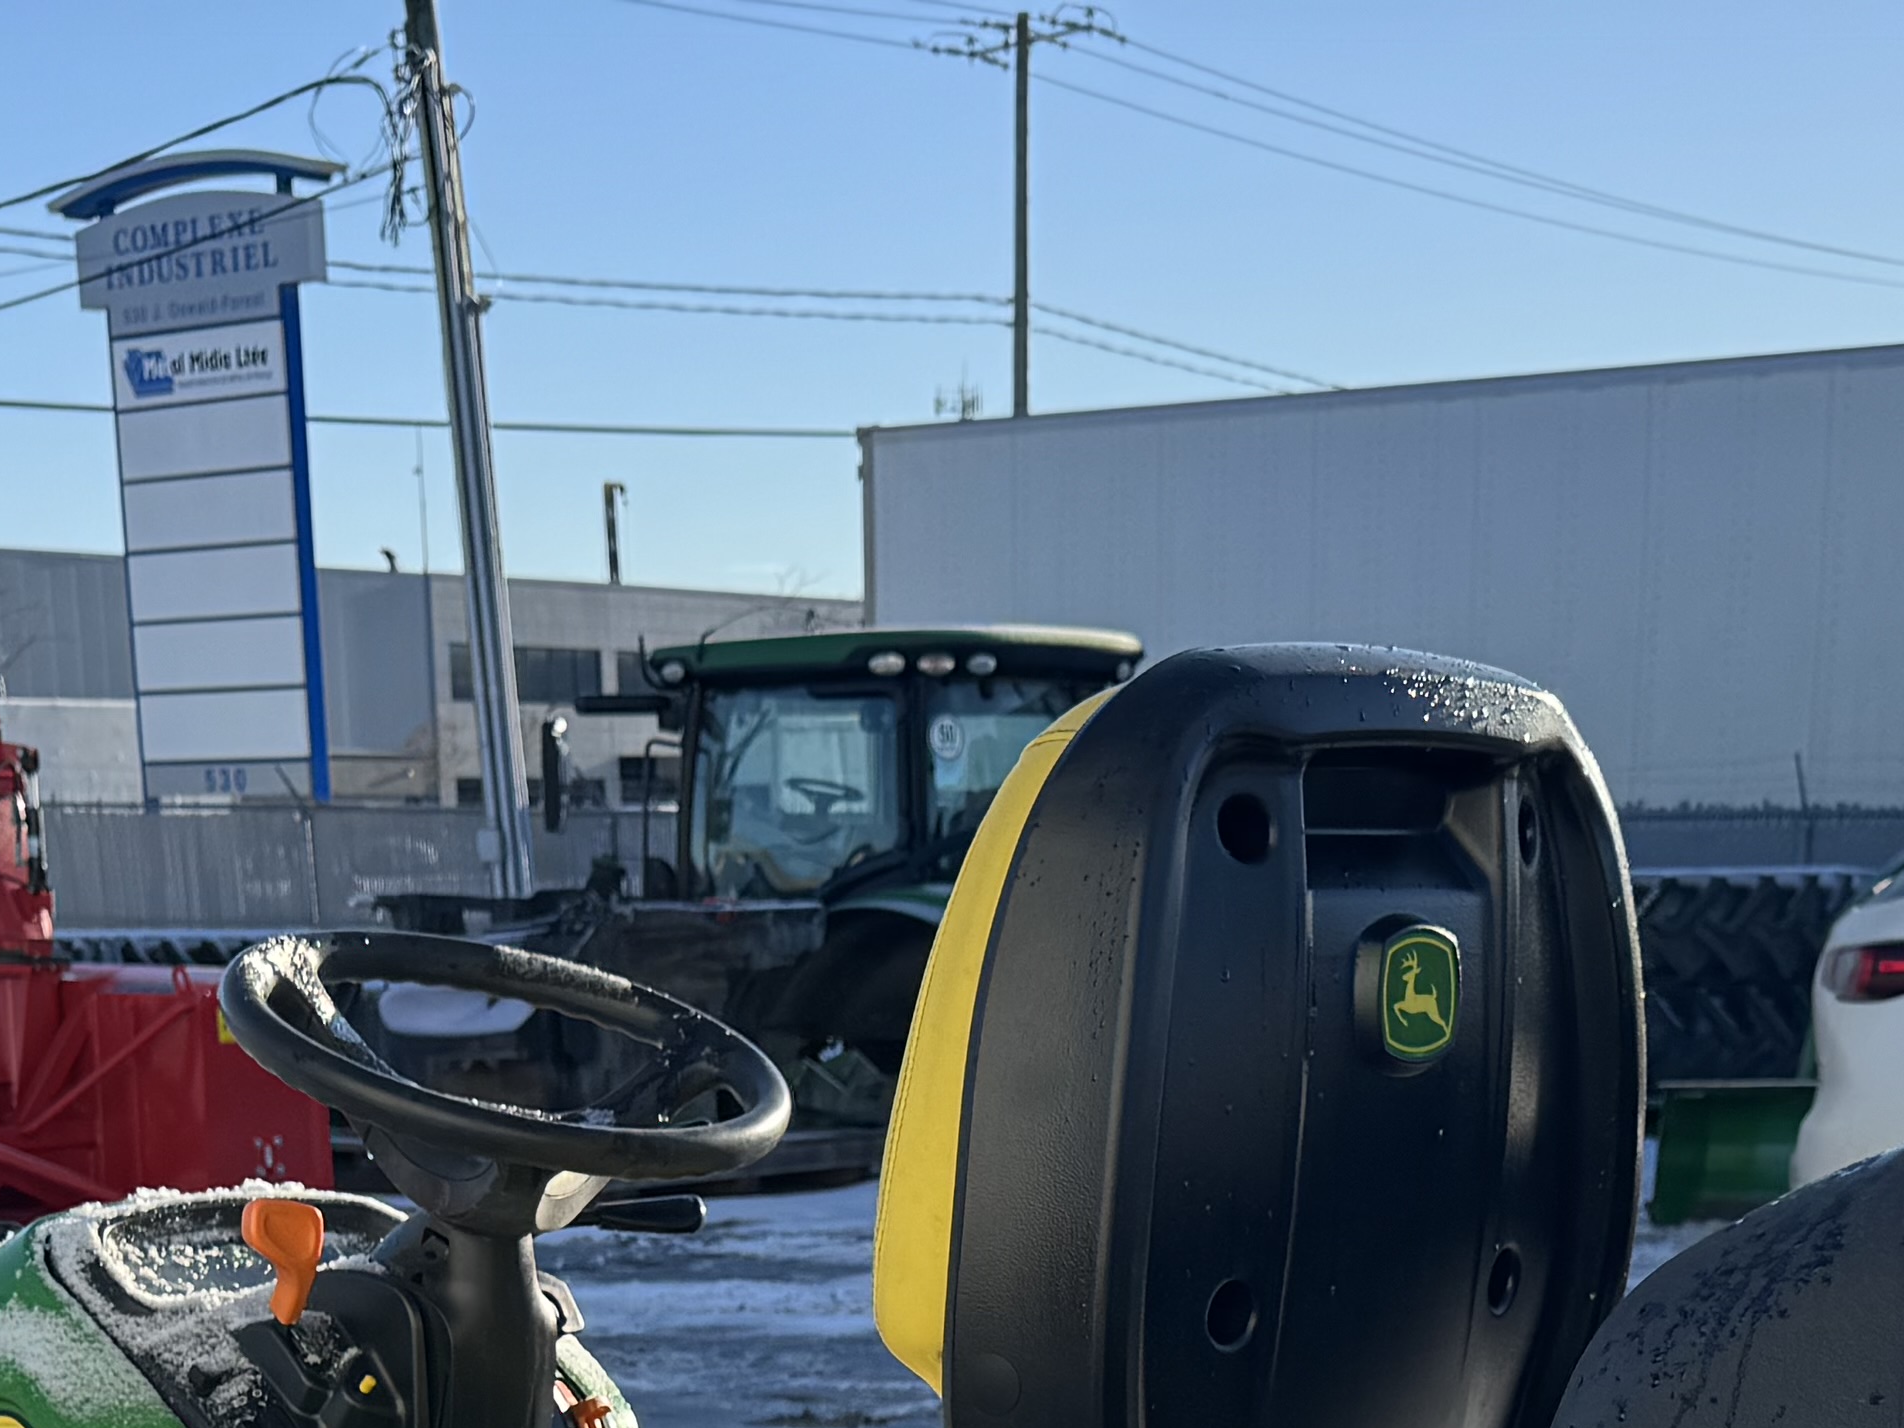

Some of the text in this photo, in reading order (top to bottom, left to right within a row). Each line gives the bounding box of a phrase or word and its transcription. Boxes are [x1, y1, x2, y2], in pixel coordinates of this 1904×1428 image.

[113, 207, 266, 257] COMPLEXE
[106, 241, 279, 291] INDUSTRIEL
[204, 767, 247, 794] 530
